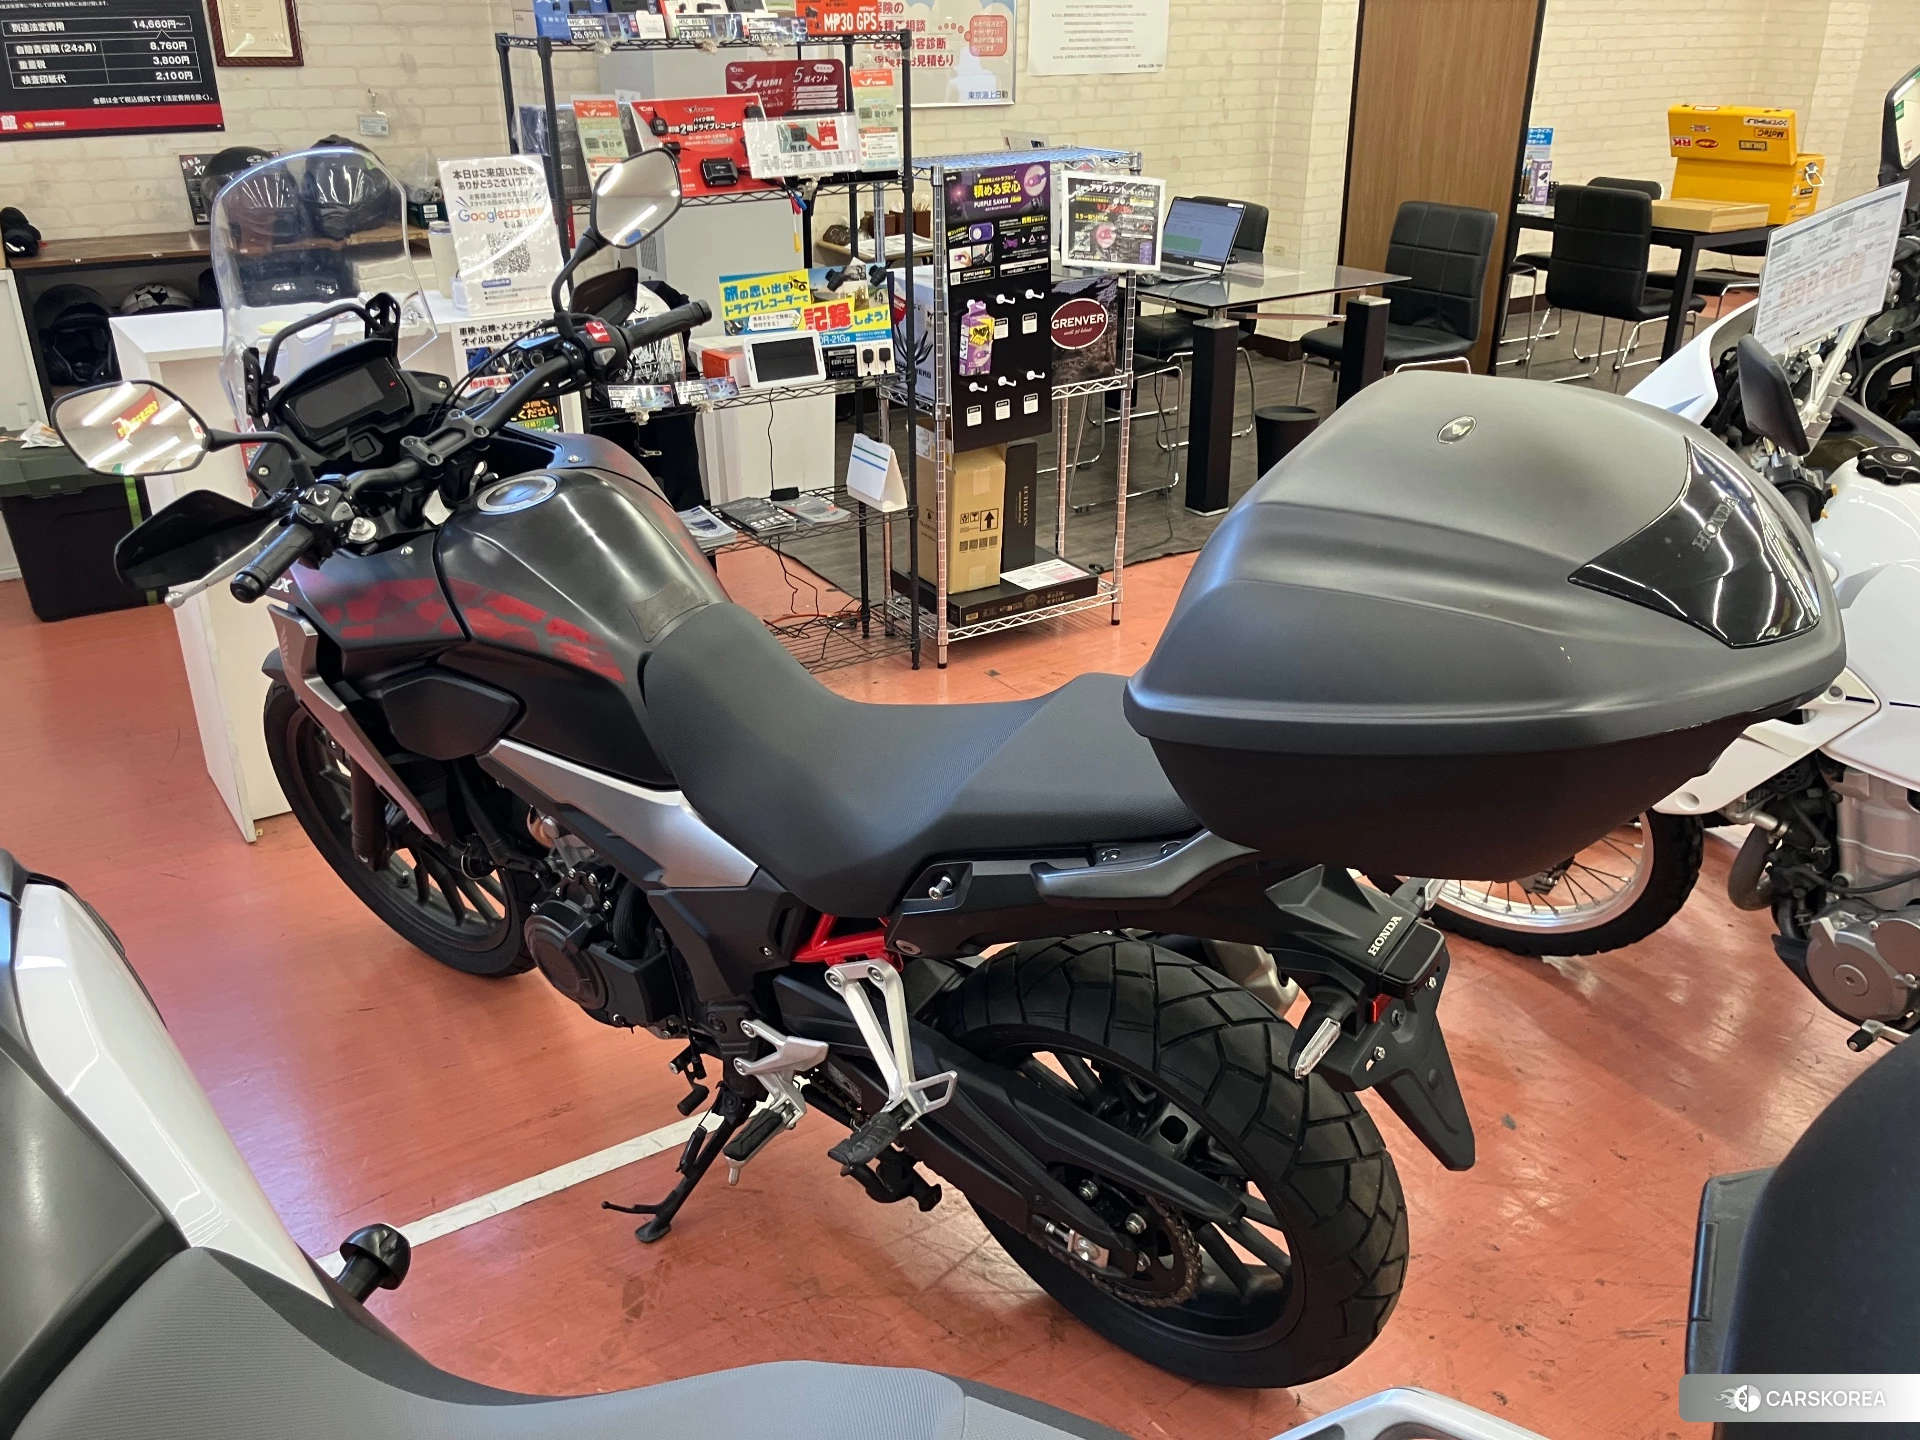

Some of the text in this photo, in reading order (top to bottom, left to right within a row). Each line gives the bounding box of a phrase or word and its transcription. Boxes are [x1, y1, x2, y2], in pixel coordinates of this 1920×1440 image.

[824, 12, 877, 31] MP30 GPS
[150, 41, 187, 51] 8,760円
[153, 56, 190, 66] 3,800円
[156, 71, 193, 81] 2,100円
[756, 78, 783, 88] YUMI
[792, 67, 829, 83] 5 ポイント
[1673, 138, 1691, 147] RK
[452, 166, 535, 180] 本日はご来店いただき
[973, 180, 1022, 198] 積める安心
[974, 199, 993, 208] PURPLE
[993, 197, 1009, 206] SAVER
[723, 282, 791, 303] 旅の思い出を
[725, 294, 809, 317] ドライブレコーダーで
[804, 302, 852, 332] 記録
[1051, 313, 1105, 330] GRENVER
[1691, 496, 1741, 552] HONDA
[1367, 914, 1403, 957] HONDA
